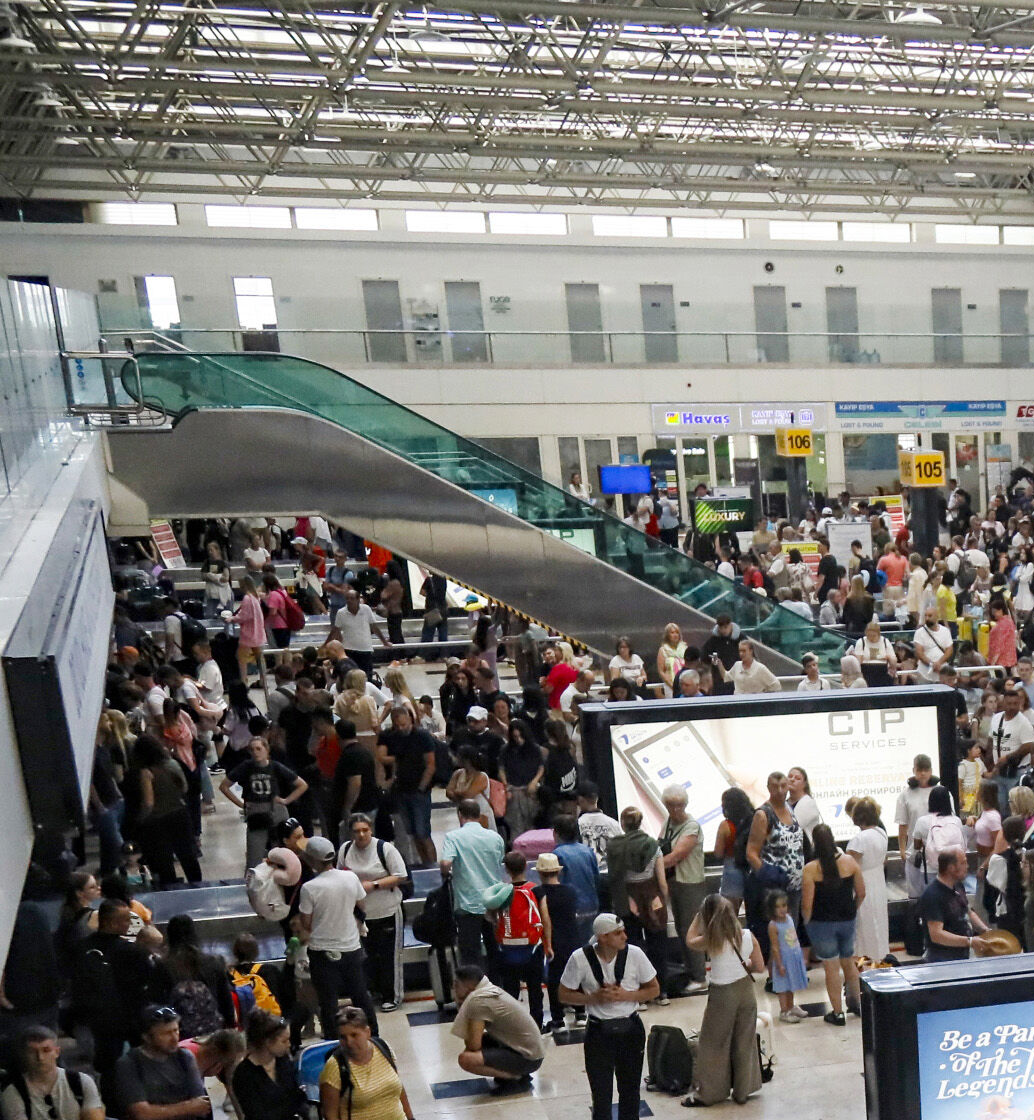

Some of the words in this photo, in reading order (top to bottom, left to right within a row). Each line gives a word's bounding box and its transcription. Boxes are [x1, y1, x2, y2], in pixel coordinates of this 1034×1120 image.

[682, 412, 730, 428] Havaş
[787, 434, 811, 449] 106
[915, 461, 943, 478] 105
[828, 708, 905, 736] CIP
[829, 738, 907, 750] SERVICES
[939, 1030, 973, 1051] Be
[975, 1032, 991, 1047] a
[949, 1051, 981, 1076] of
[975, 1048, 1021, 1077] The
